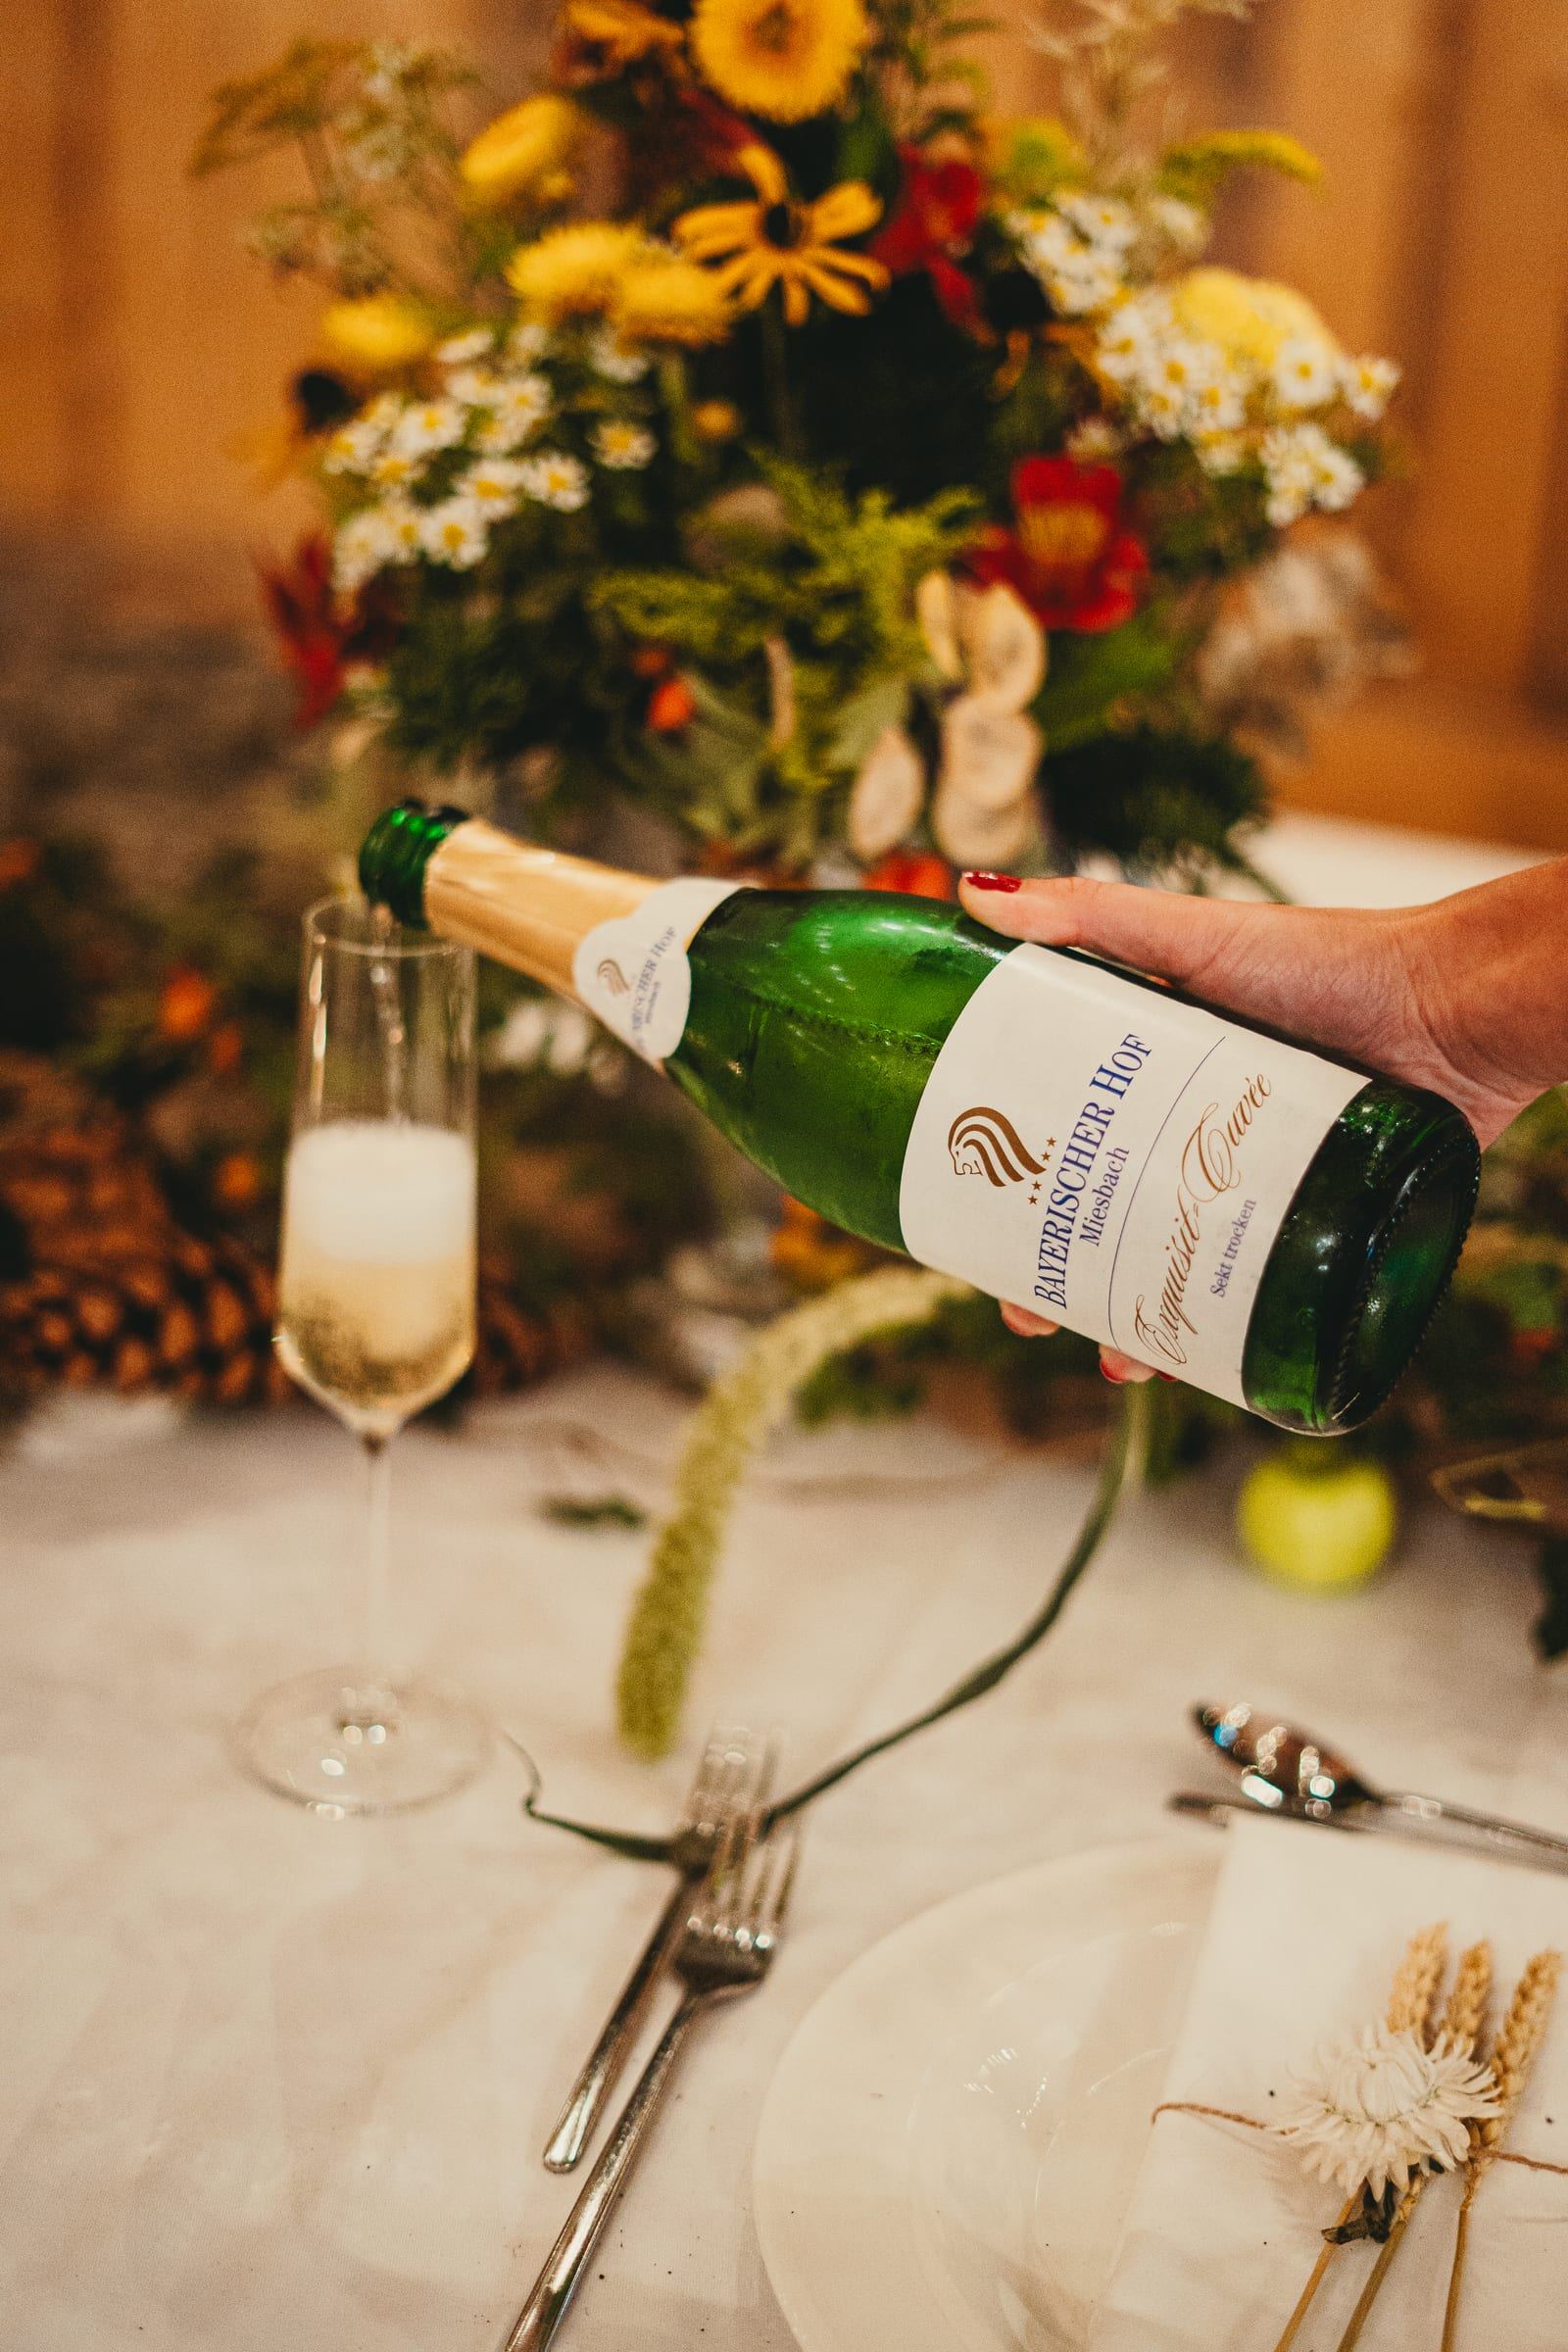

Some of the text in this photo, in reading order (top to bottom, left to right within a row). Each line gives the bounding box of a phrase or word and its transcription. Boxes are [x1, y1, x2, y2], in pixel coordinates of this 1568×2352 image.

[1035, 1034, 1152, 1309] BAYERISCHER HOF
[1079, 1146, 1130, 1247] Miesbach
[1210, 1200, 1256, 1298] Sekt trocken
